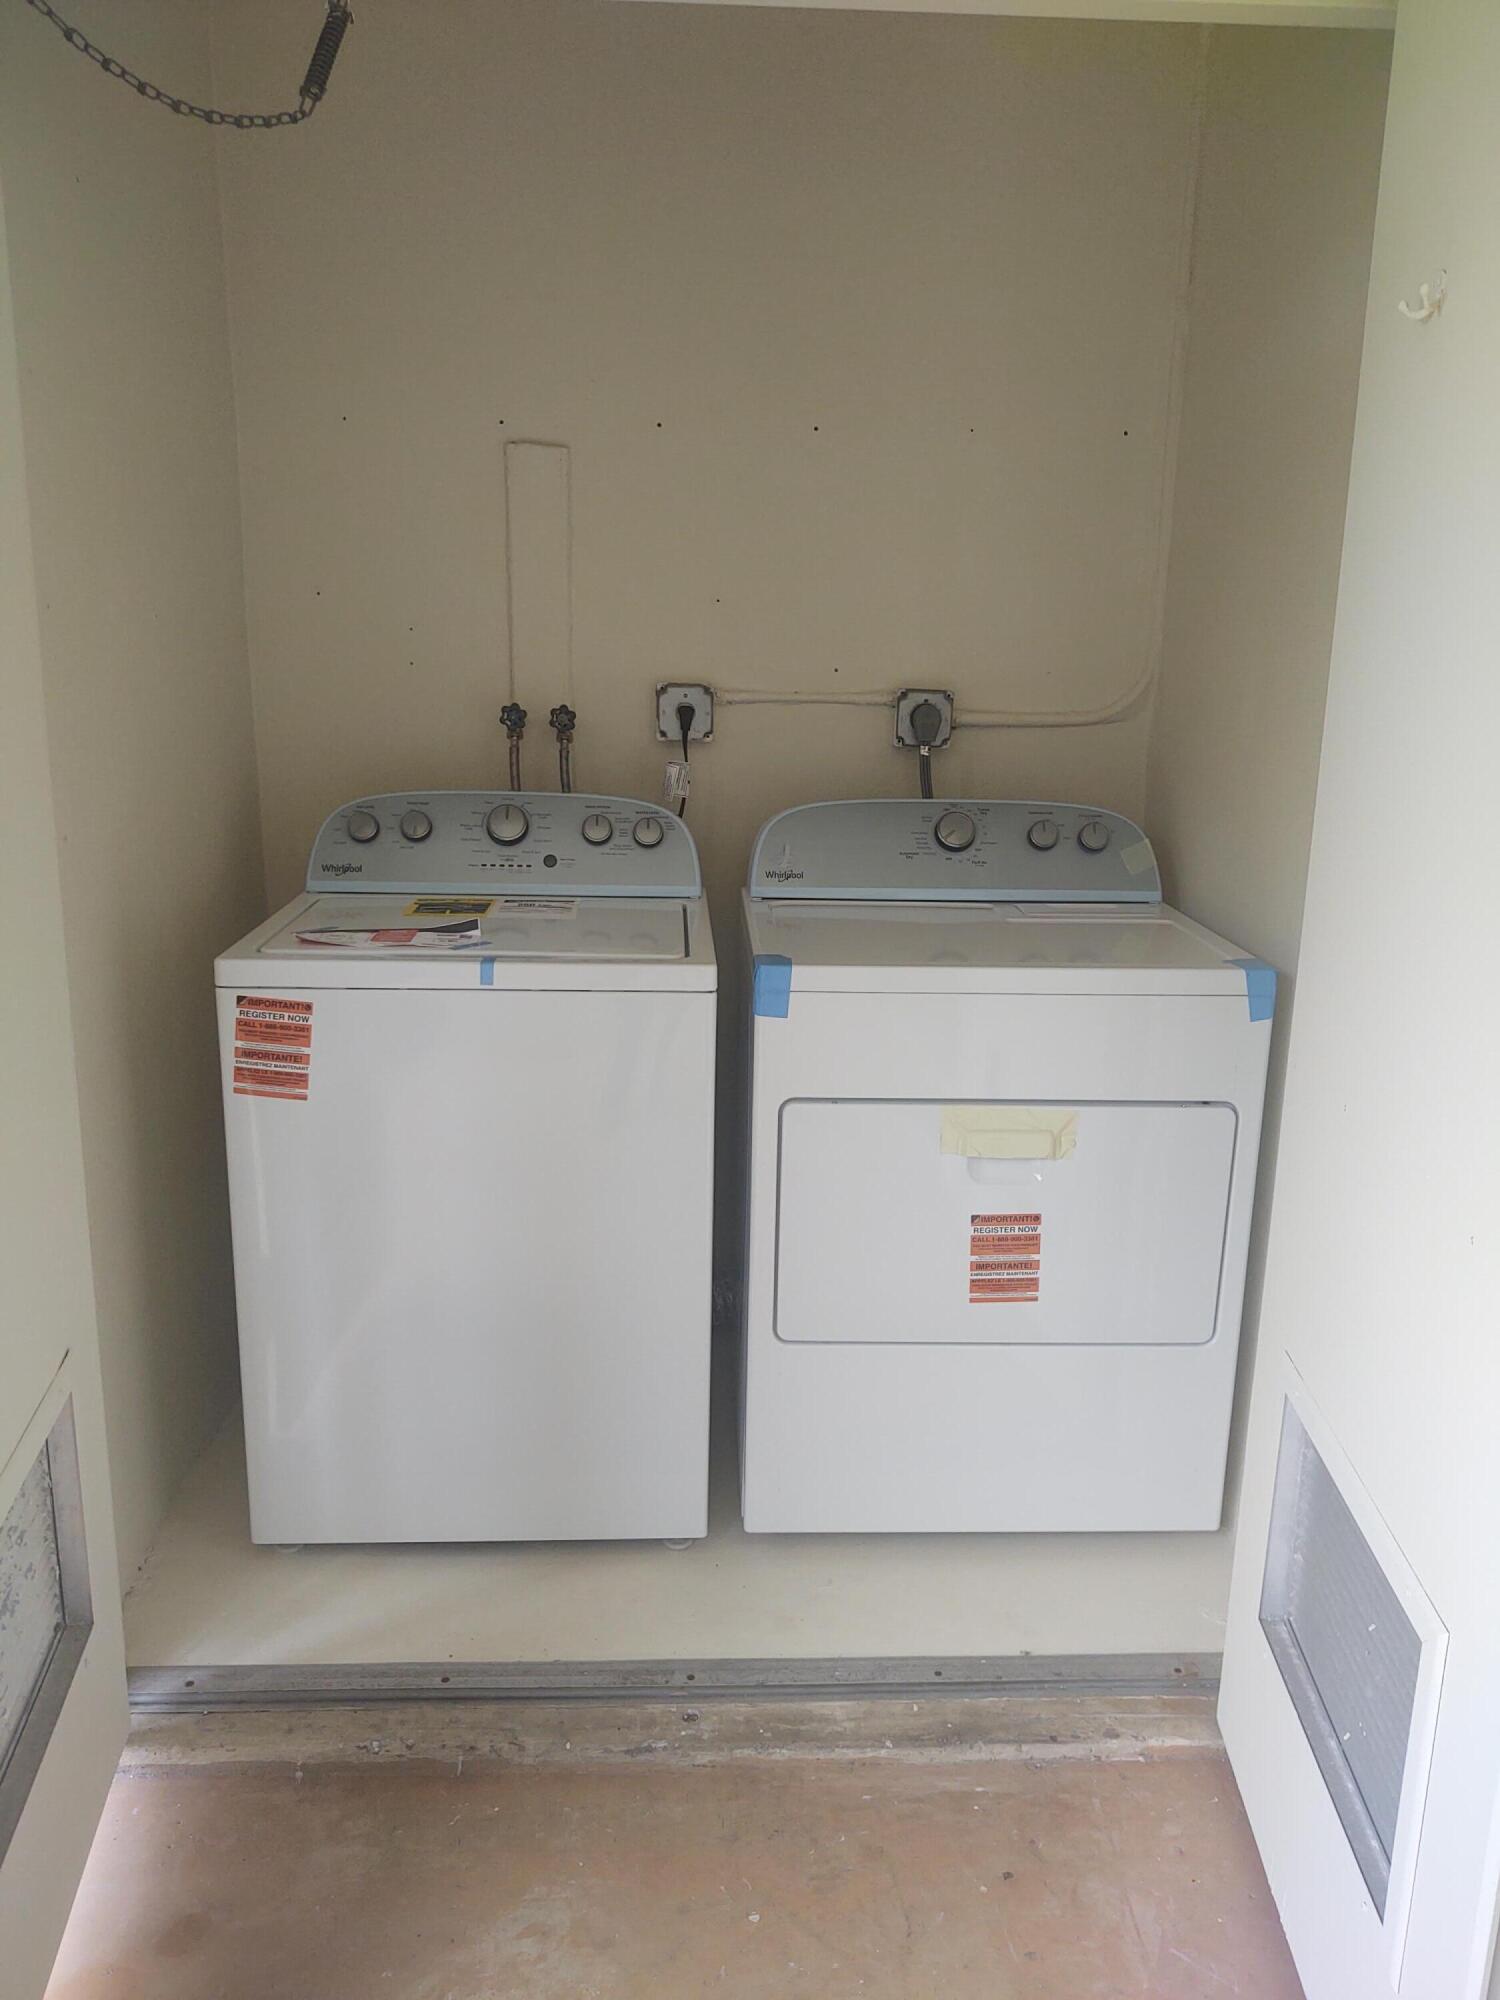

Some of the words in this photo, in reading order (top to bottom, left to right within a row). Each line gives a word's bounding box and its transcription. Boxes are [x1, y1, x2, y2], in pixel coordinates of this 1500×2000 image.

[321, 863, 363, 877] Whirlpool
[765, 868, 804, 883] Whirlpool
[239, 1010, 285, 1021] REGISTER
[287, 1014, 310, 1023] NOW
[238, 1020, 257, 1029] CALL
[973, 1226, 1016, 1234] REGISTER
[972, 1235, 990, 1243] CALL
